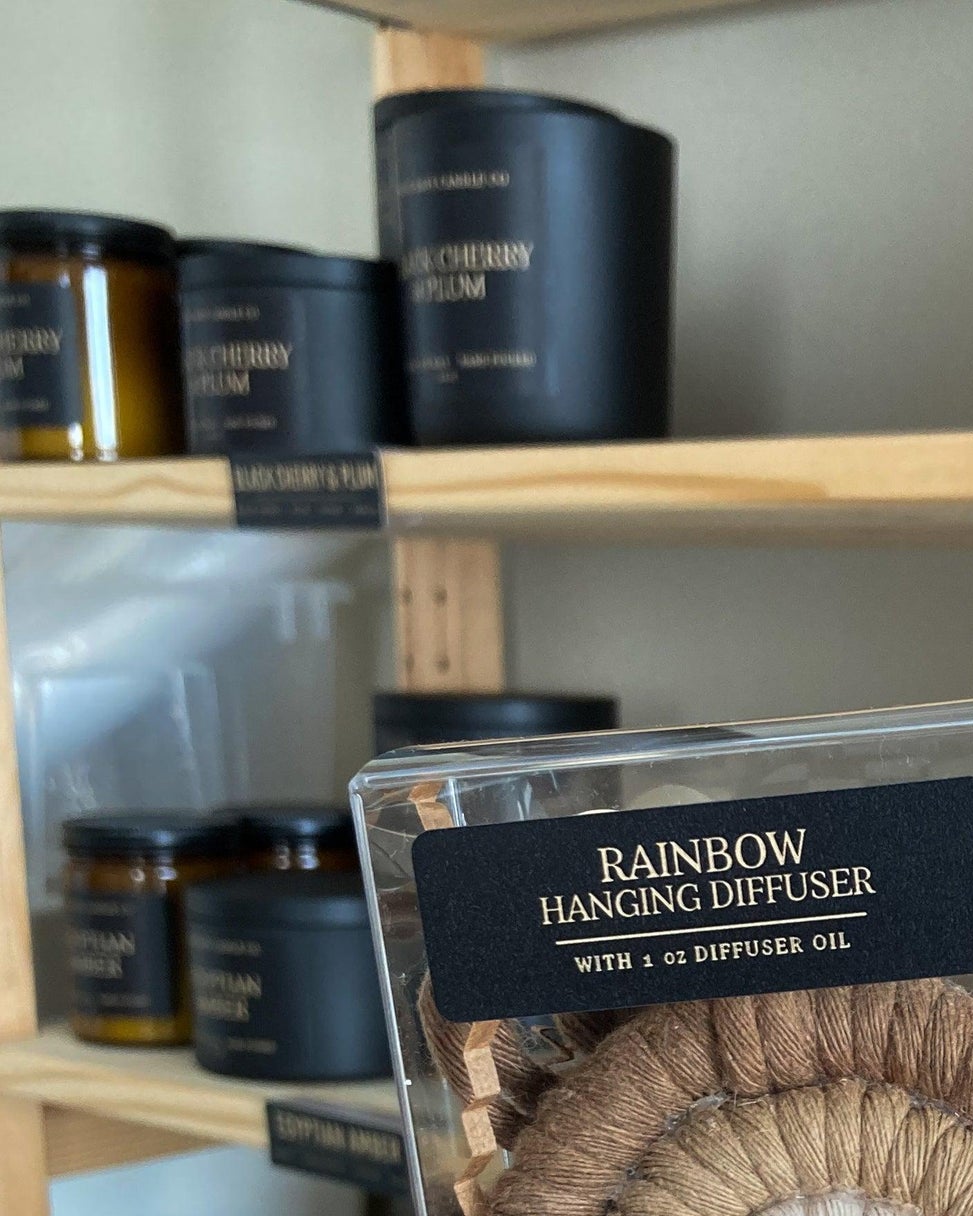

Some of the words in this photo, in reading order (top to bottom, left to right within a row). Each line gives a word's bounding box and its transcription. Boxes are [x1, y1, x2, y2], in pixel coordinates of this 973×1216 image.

[597, 828, 806, 883] RAINBOW
[539, 884, 701, 925] HANGING
[709, 866, 876, 909] DIFFUSER
[575, 952, 633, 973] WITH
[643, 953, 654, 967] 1
[694, 936, 804, 963] DIFFUSER
[812, 931, 851, 951] OIL
